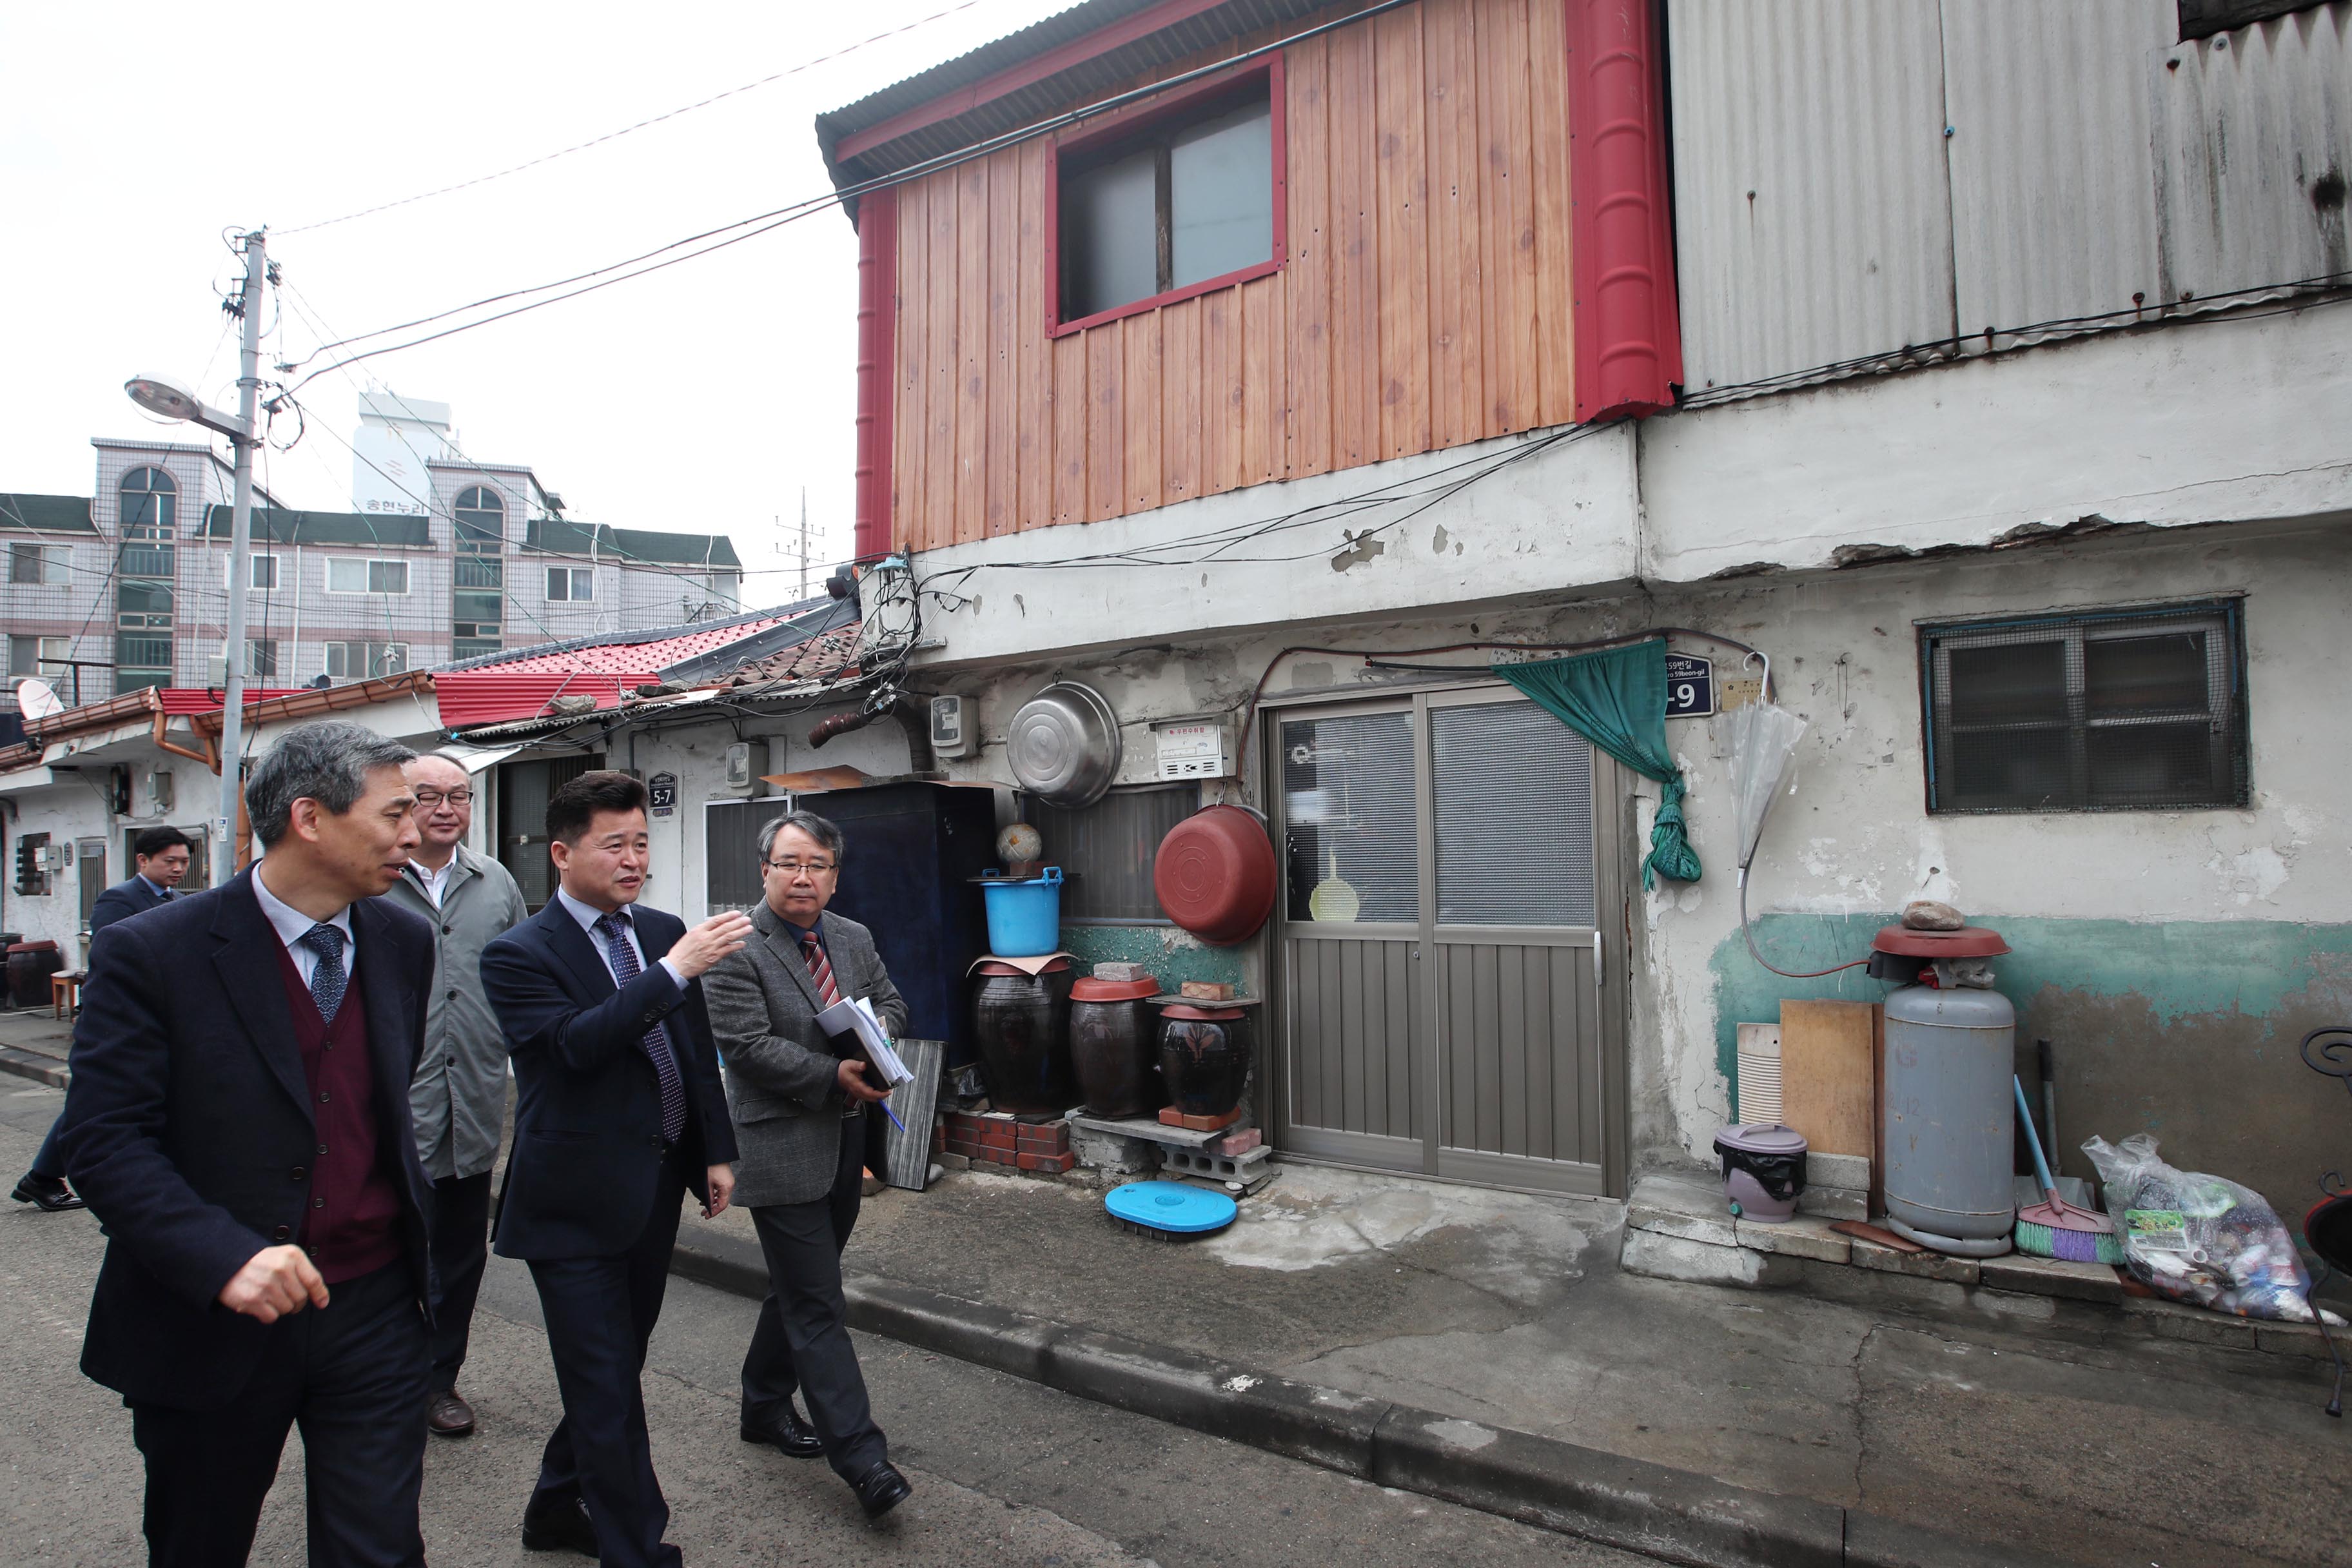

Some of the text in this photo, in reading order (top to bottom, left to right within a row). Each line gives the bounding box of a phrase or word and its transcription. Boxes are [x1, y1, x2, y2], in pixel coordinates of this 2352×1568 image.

[366, 499, 424, 514] 송현누리
[1665, 660, 1692, 670] 59번길
[1675, 669, 1705, 677] 59beon-gil
[1177, 727, 1204, 735] 우편수취함
[654, 789, 671, 804] 5-7
